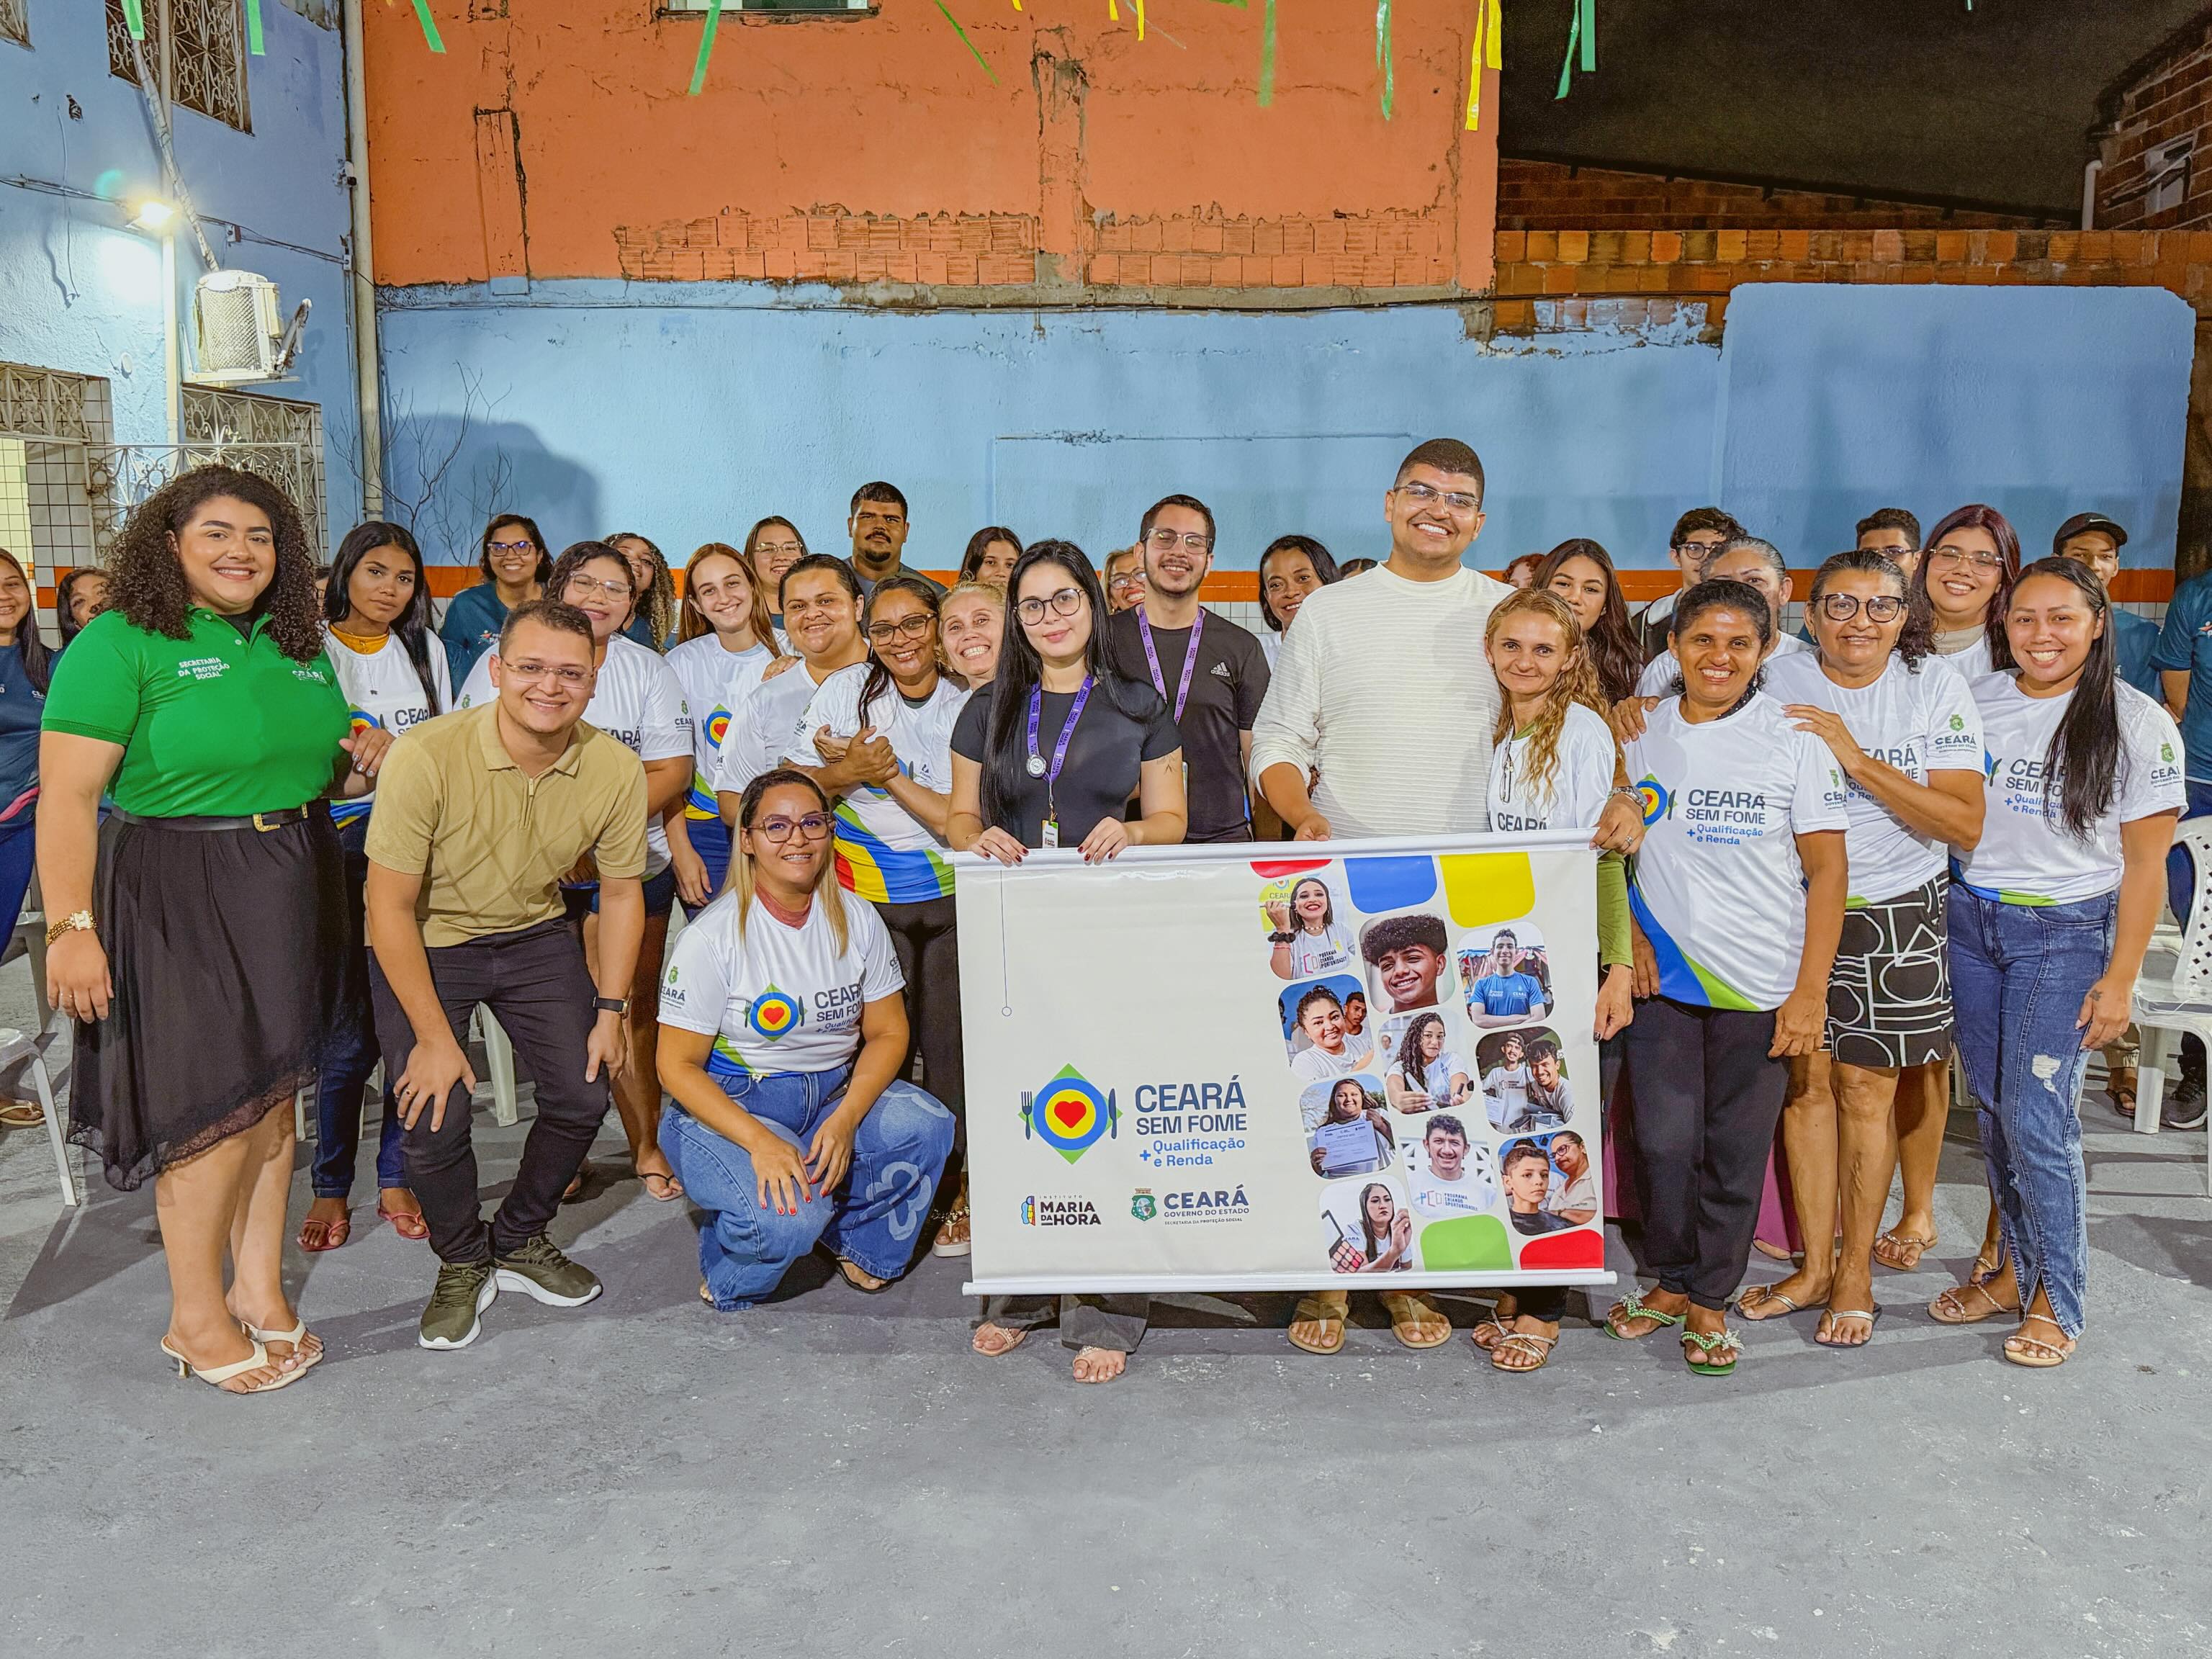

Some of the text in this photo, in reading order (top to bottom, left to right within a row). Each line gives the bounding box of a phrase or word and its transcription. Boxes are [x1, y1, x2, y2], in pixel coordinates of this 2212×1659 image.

[179, 657, 221, 668] SECRETARIA
[192, 662, 230, 675] PROTEÇÃO
[196, 671, 223, 680] SOCIAL
[1935, 733, 1976, 745] CEARÁ
[2006, 777, 2039, 793] SEM
[1688, 789, 1766, 810] CEARÁ
[1686, 809, 1766, 825] SEM FOME
[1697, 824, 1763, 837] Qualificação
[1706, 835, 1740, 845] Renda
[814, 984, 862, 1009] CEAR
[817, 1008, 843, 1022] SEM
[1135, 1074, 1246, 1113] CEARÁ
[1136, 1113, 1247, 1136] SEM FOME
[1153, 1137, 1246, 1154] Qualificação
[1154, 1154, 1213, 1167] e Renda
[1164, 1184, 1249, 1210] CEARÁ
[1040, 1201, 1096, 1213] MARIA
